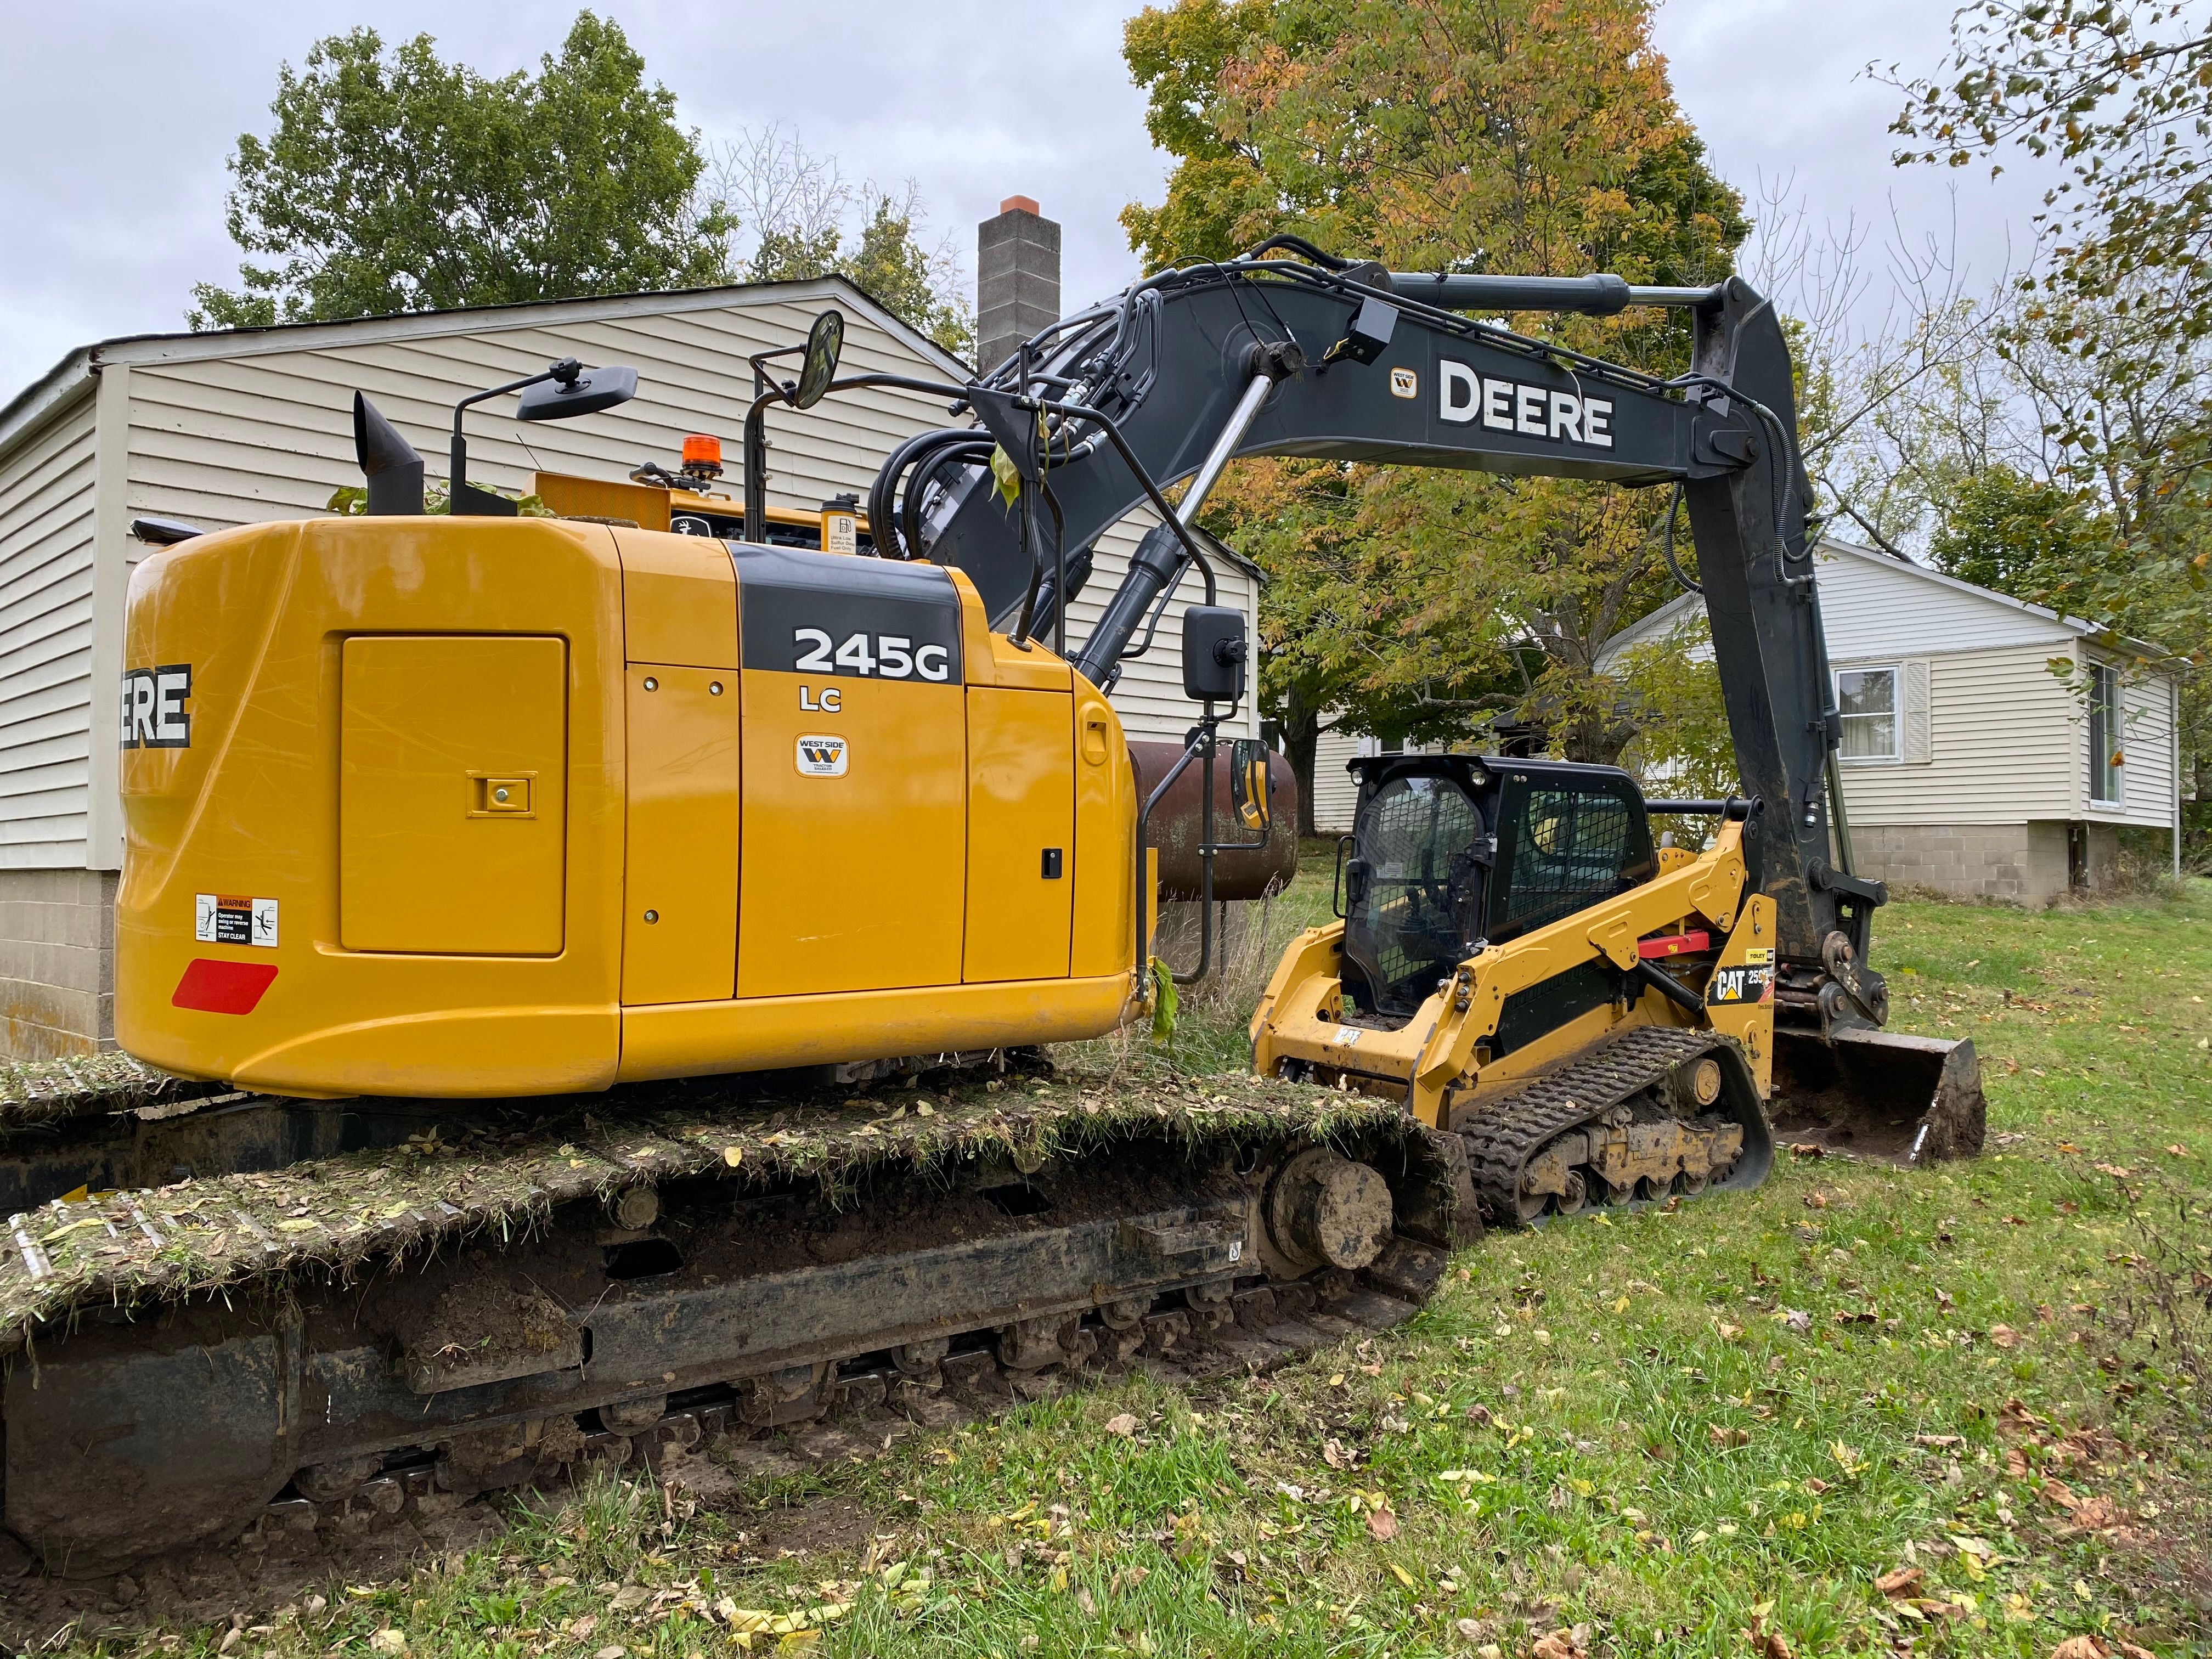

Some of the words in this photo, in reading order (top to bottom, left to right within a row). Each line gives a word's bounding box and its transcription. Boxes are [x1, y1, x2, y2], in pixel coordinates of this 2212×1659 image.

[1440, 359, 1612, 447] DEERE
[795, 628, 948, 680] 245G
[800, 686, 840, 712] LC
[223, 899, 251, 908] WARNING
[1717, 970, 1745, 1000] CAT
